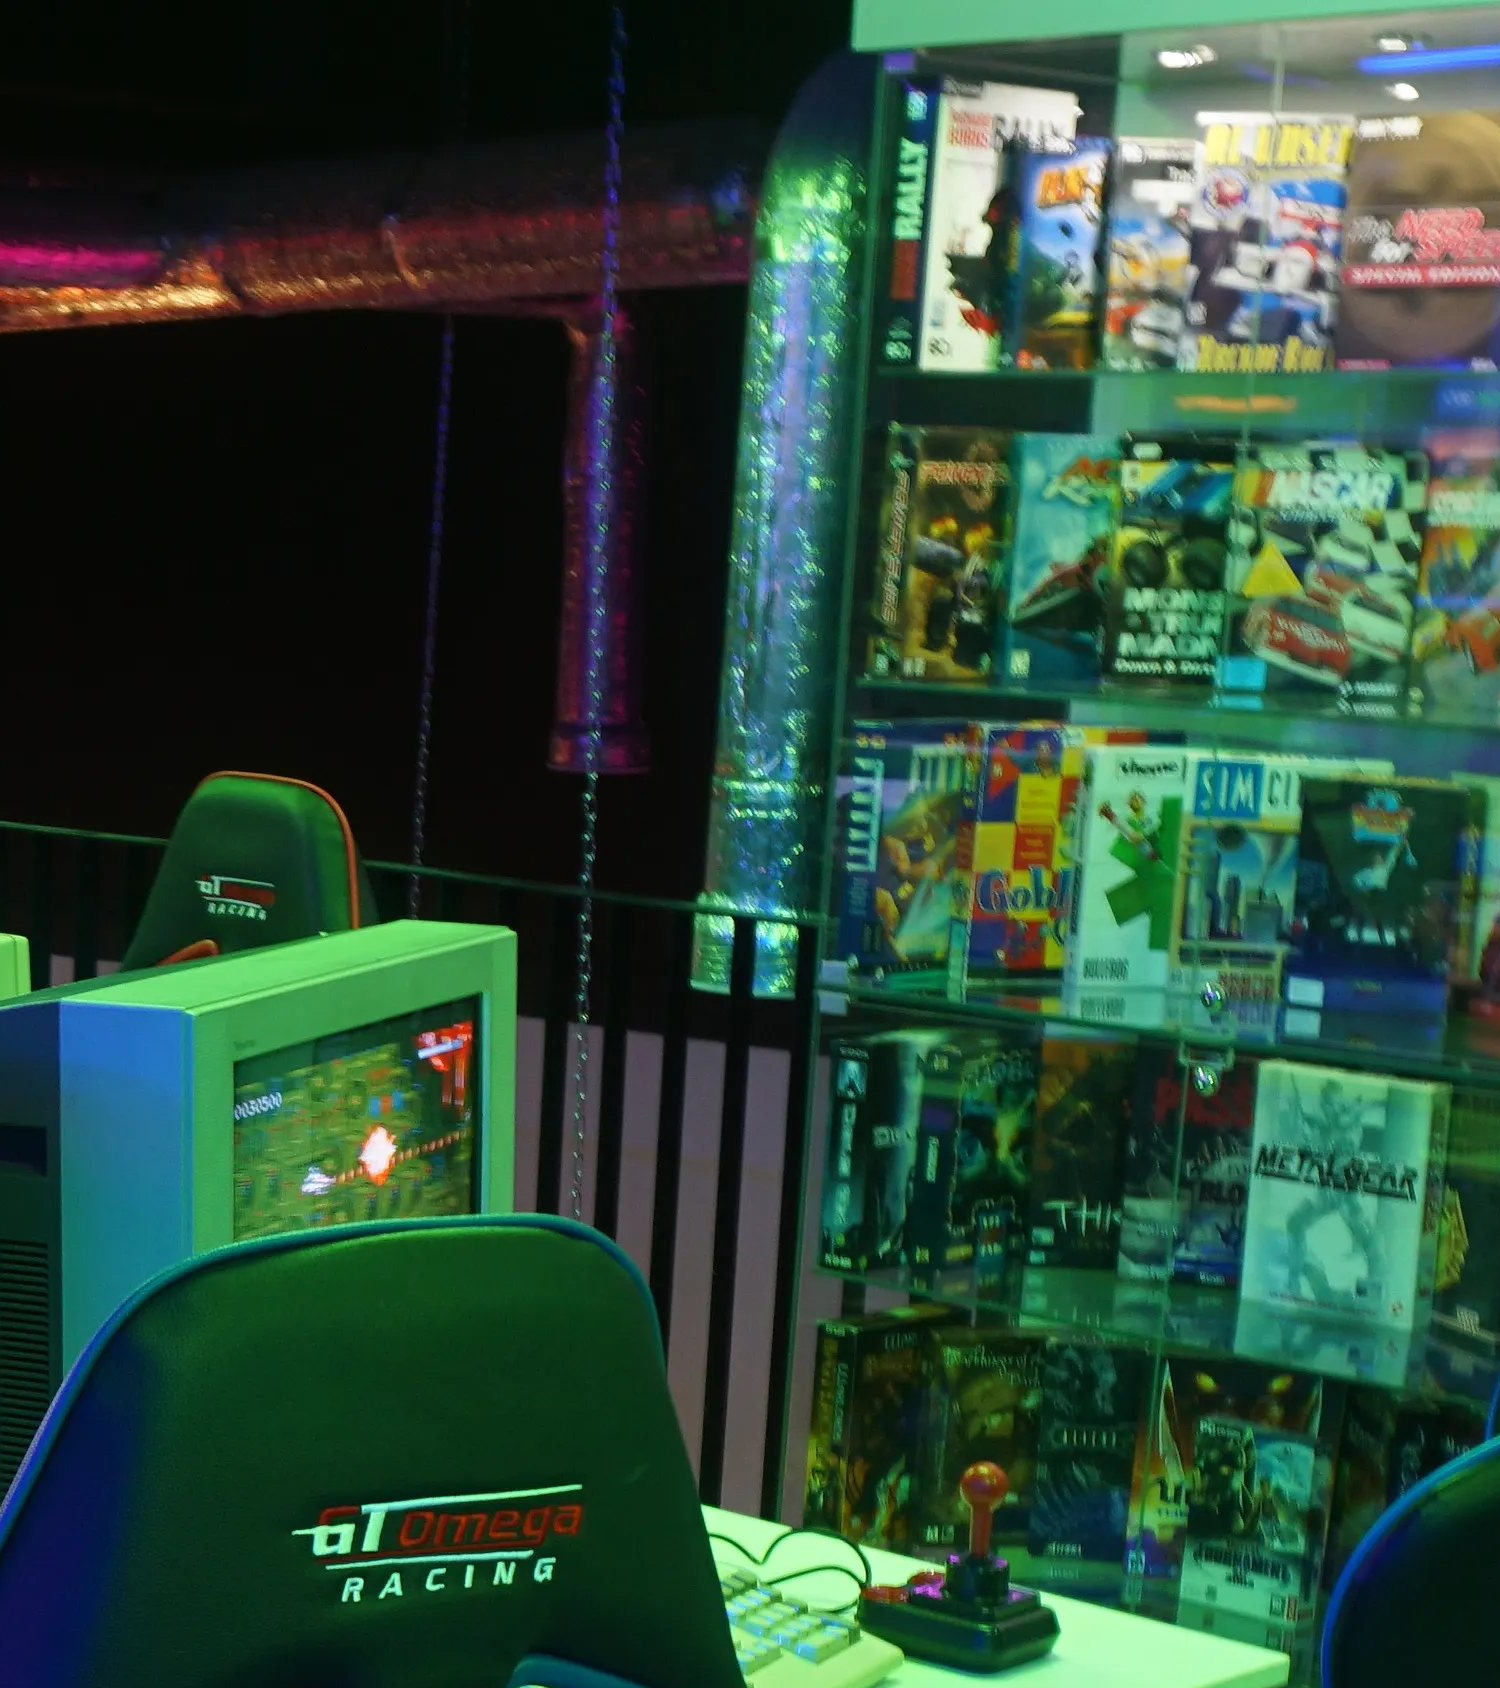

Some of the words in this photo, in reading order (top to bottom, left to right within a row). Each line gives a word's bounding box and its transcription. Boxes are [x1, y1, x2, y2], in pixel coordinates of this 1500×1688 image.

[895, 135, 930, 240] RALLY
[1201, 763, 1260, 813] SIM
[976, 862, 1071, 914] Gobl
[400, 1504, 583, 1547] Omega
[341, 1557, 557, 1603] RACING
